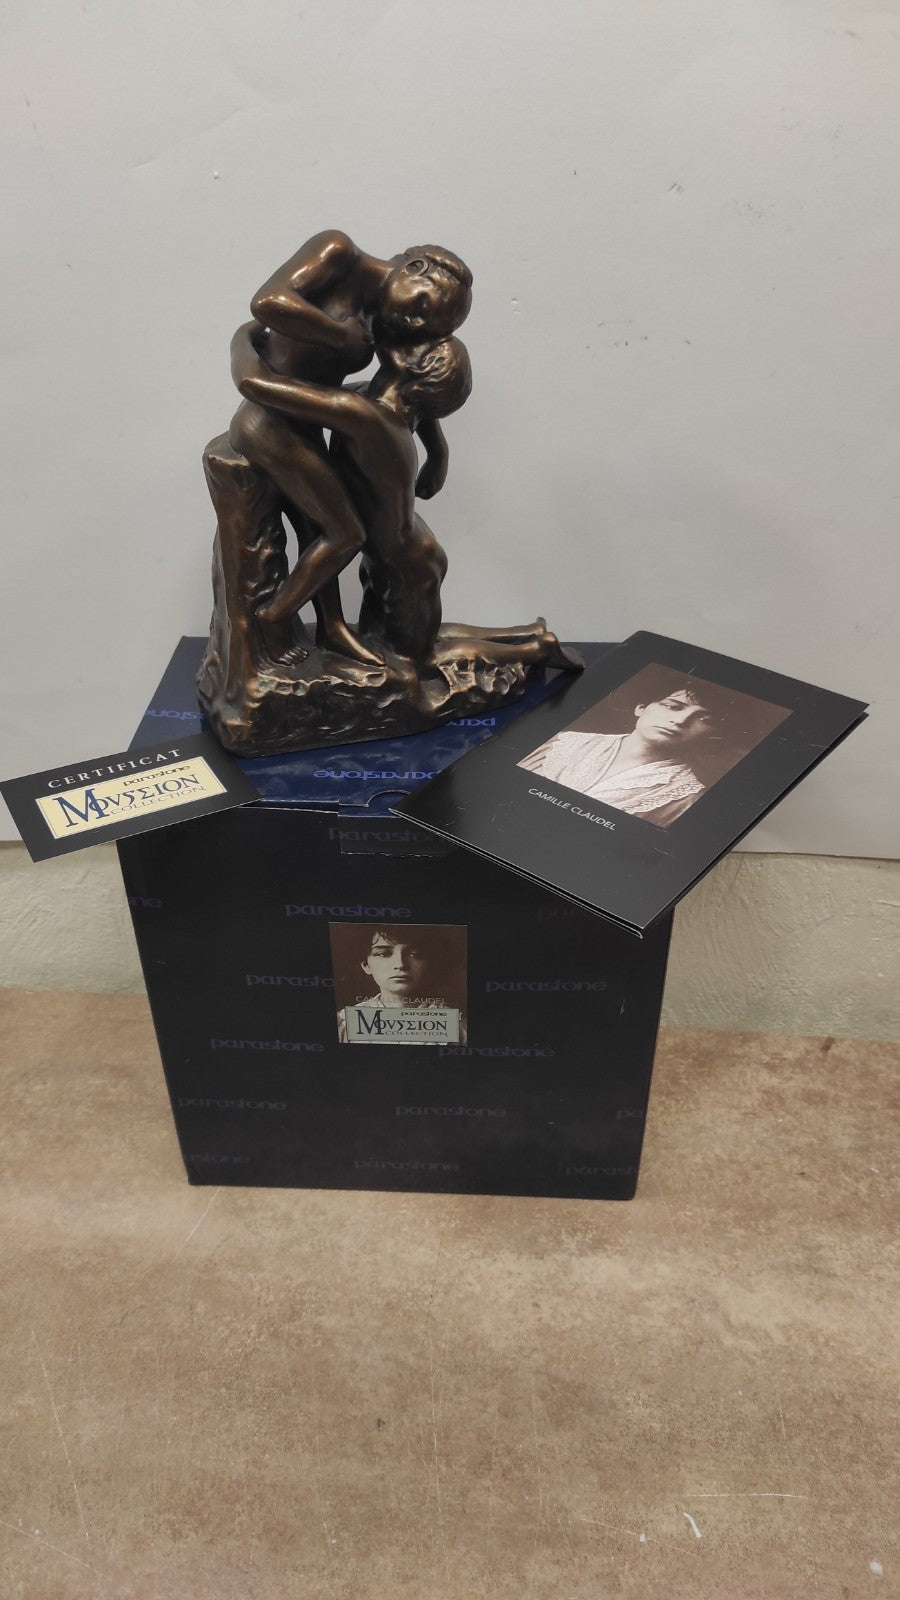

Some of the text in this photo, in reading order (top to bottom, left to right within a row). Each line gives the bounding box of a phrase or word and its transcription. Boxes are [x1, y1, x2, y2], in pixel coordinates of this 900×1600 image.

[47, 749, 181, 789] CERTIFICAT
[123, 765, 190, 787] parastone
[110, 785, 207, 815] COLLECTION
[528, 788, 616, 831] CAMILLE CLAUDEL
[285, 902, 412, 917] parastone
[485, 979, 608, 993] parastone
[401, 997, 447, 1005] CLAUDEL
[209, 1037, 325, 1052] parastone
[438, 1045, 556, 1058] parastone
[178, 1096, 288, 1111] parastone
[395, 1104, 507, 1118] parastone
[353, 1158, 460, 1172] parastone
